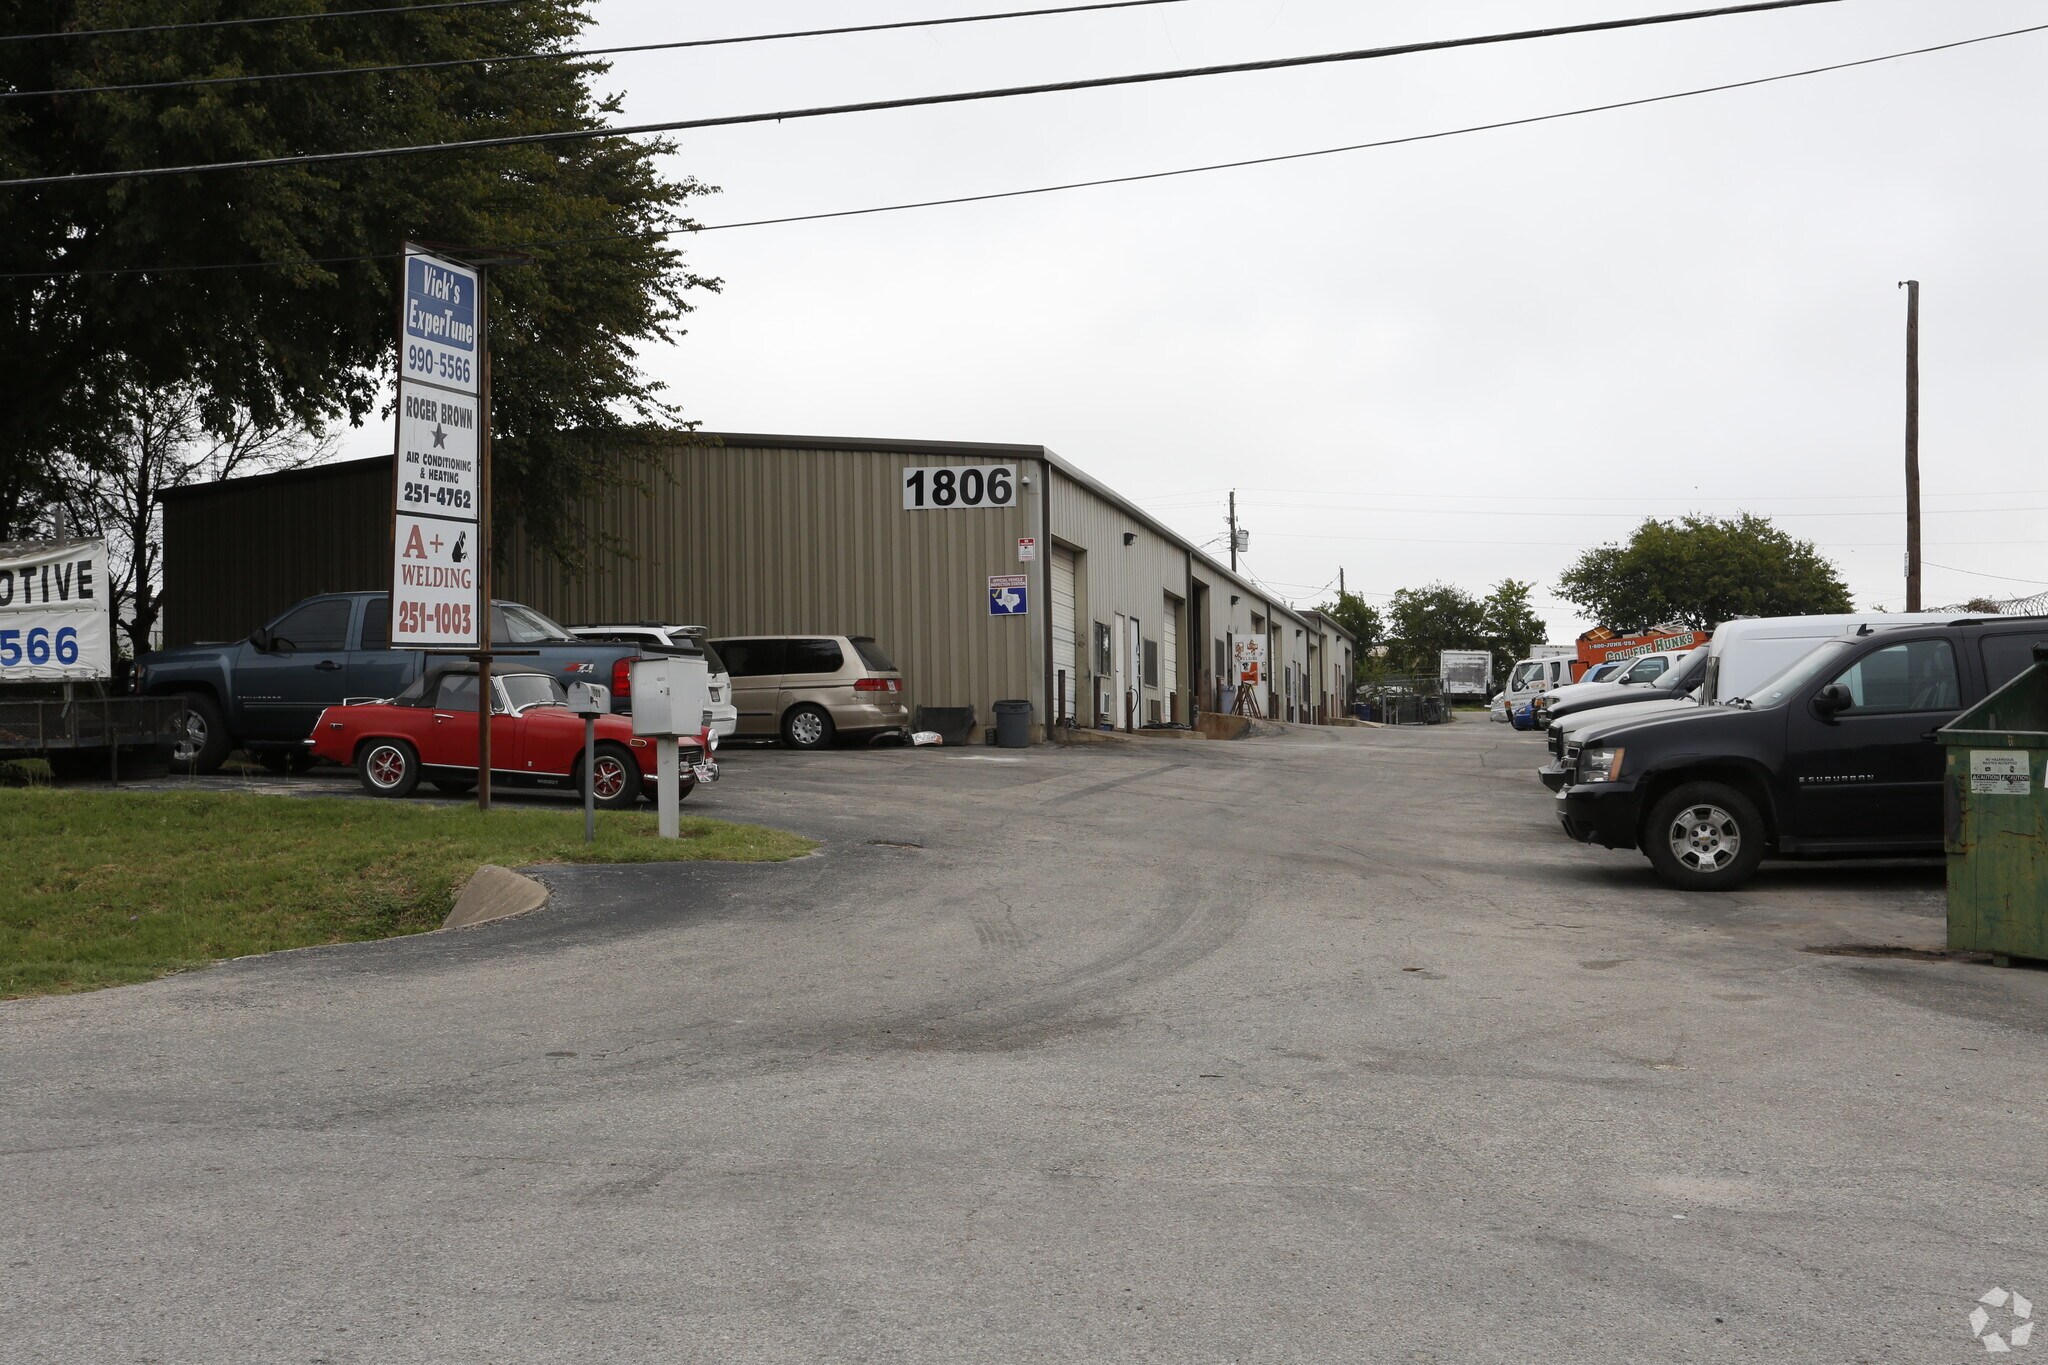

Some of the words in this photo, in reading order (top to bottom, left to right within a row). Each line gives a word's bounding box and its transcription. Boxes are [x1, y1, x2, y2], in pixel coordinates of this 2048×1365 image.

[423, 264, 461, 305] Vick's
[408, 298, 473, 344] ExperTune
[409, 344, 471, 383] 990-5566
[406, 395, 437, 422] ROGER
[441, 408, 473, 430] BROWN
[406, 451, 420, 464] AIR
[422, 454, 472, 472] CONDITIONING
[419, 467, 426, 479] &
[428, 469, 459, 484] HEATING
[404, 482, 471, 509] 251-4762
[906, 468, 1013, 507] 1806
[403, 524, 444, 560] A+
[0, 560, 94, 607] OTIVE
[401, 564, 472, 590] WELDING
[399, 600, 471, 635] 251-1003
[1605, 643, 1652, 660] COLLEGE
[1654, 633, 1695, 652] HUNKS
